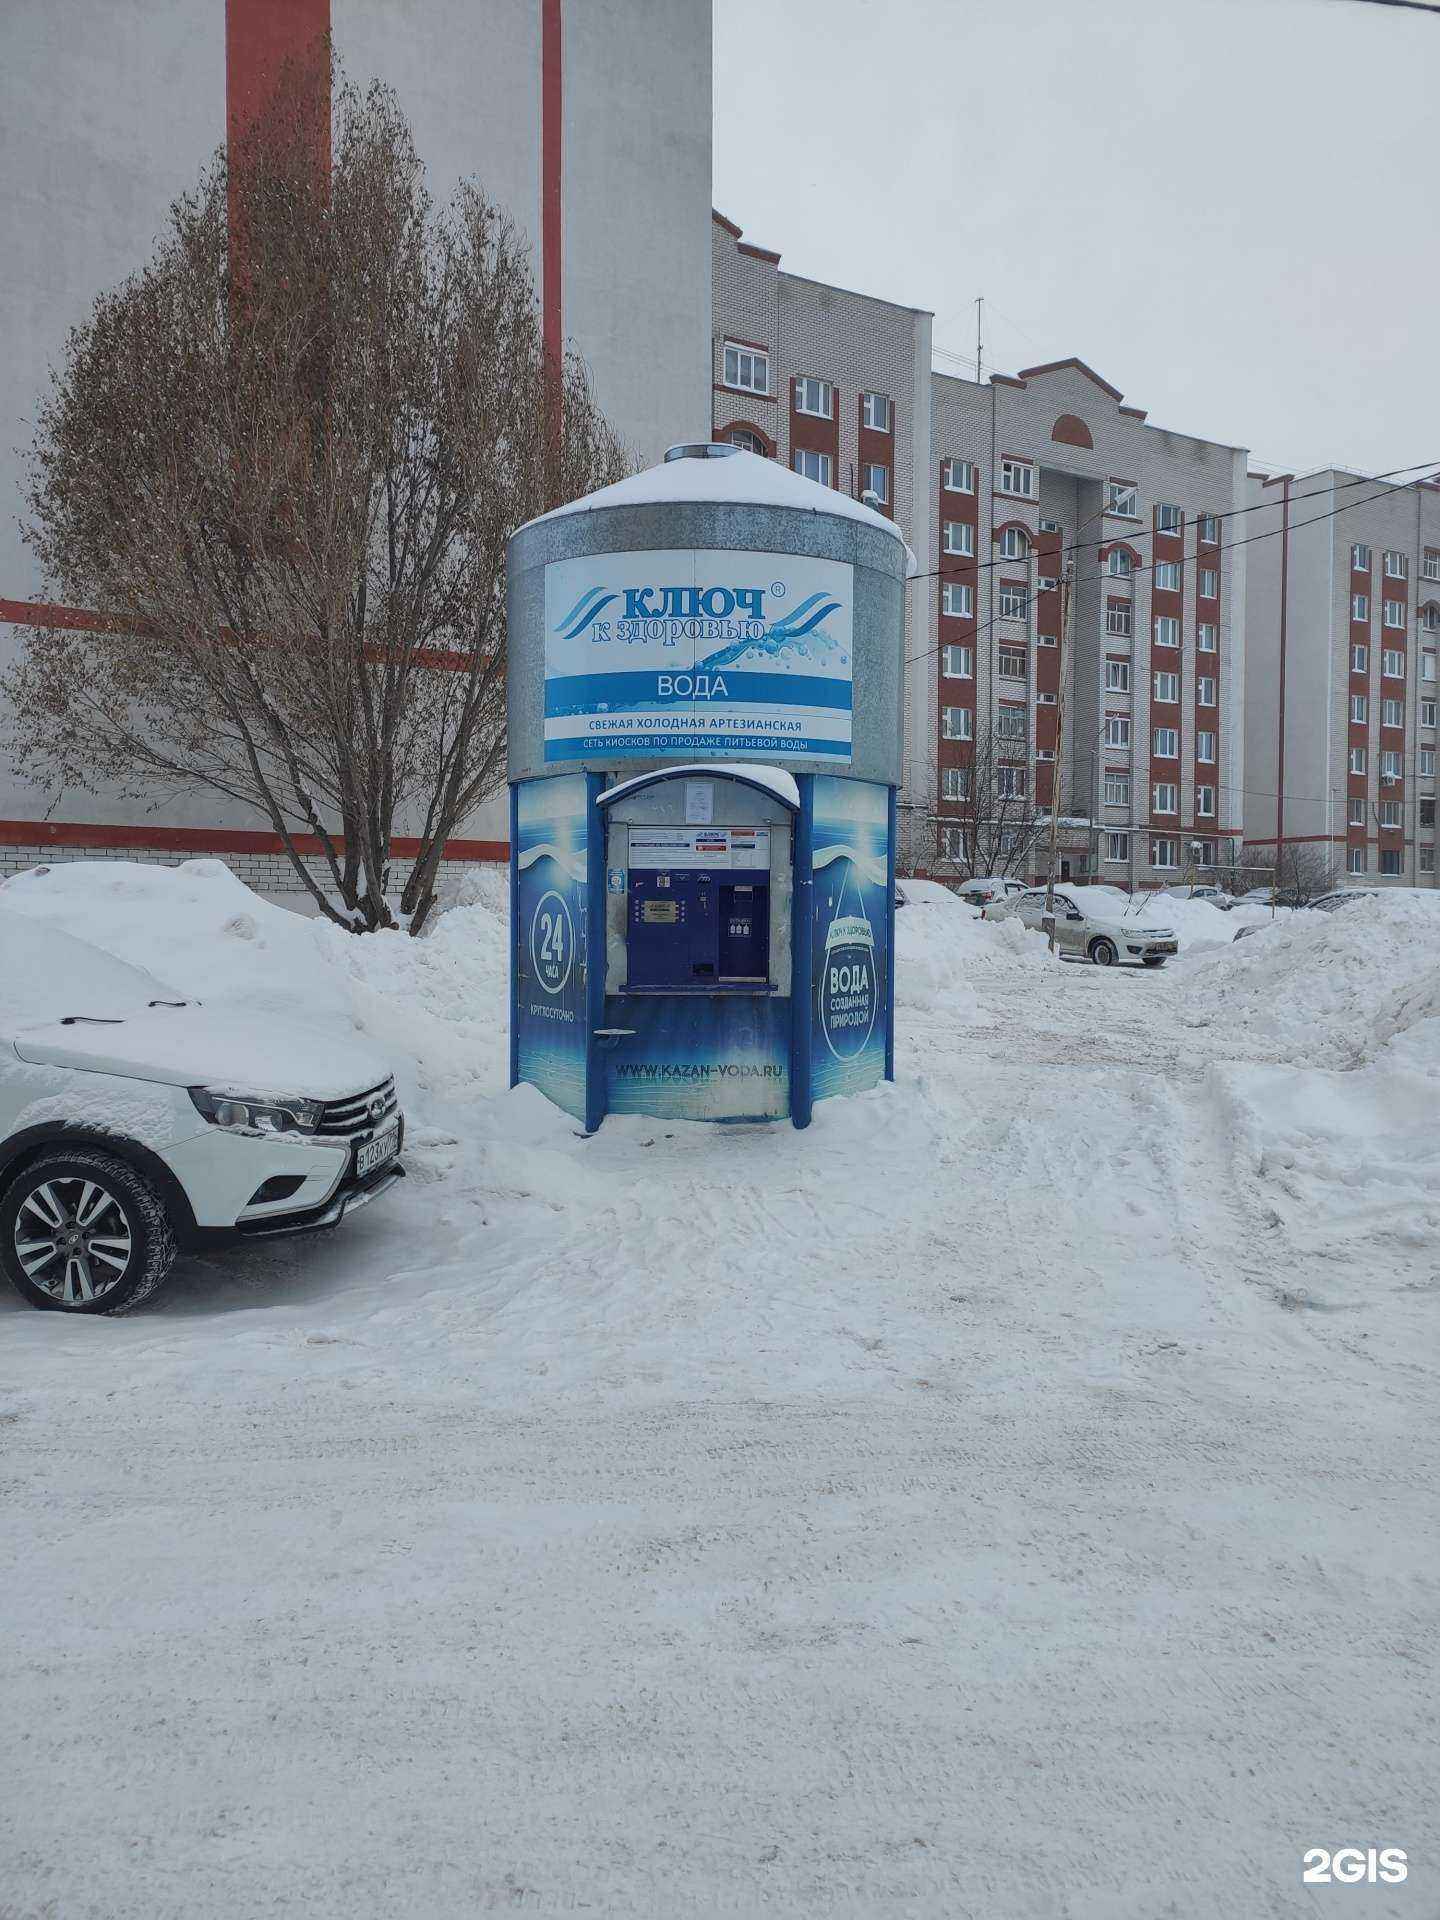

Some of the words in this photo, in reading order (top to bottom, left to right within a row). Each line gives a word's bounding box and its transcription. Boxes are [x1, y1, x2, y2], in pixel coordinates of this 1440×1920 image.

[622, 587, 766, 620] КЛЮЧ
[617, 619, 765, 646] здоровью
[658, 675, 729, 700] ВОДА
[589, 719, 633, 730] СВЕЖАЯ
[637, 718, 706, 730] ХОЛОДНАЯ
[709, 718, 802, 731] АРТЕЗИАНСКАЯ
[583, 738, 604, 748] СЕТЬ
[605, 737, 650, 747] КИОСКОВ
[653, 736, 668, 746] ПО
[671, 736, 721, 747] ПРОДАЖЕ
[724, 737, 778, 748] ПИТЬЕВОЙ
[780, 740, 808, 751] ВОДЫ
[540, 912, 564, 962] 24
[830, 964, 869, 995] ВОДА
[830, 994, 869, 1012] СОЗДАННАЯ
[830, 1005, 869, 1030] ПРИРОДОЙ
